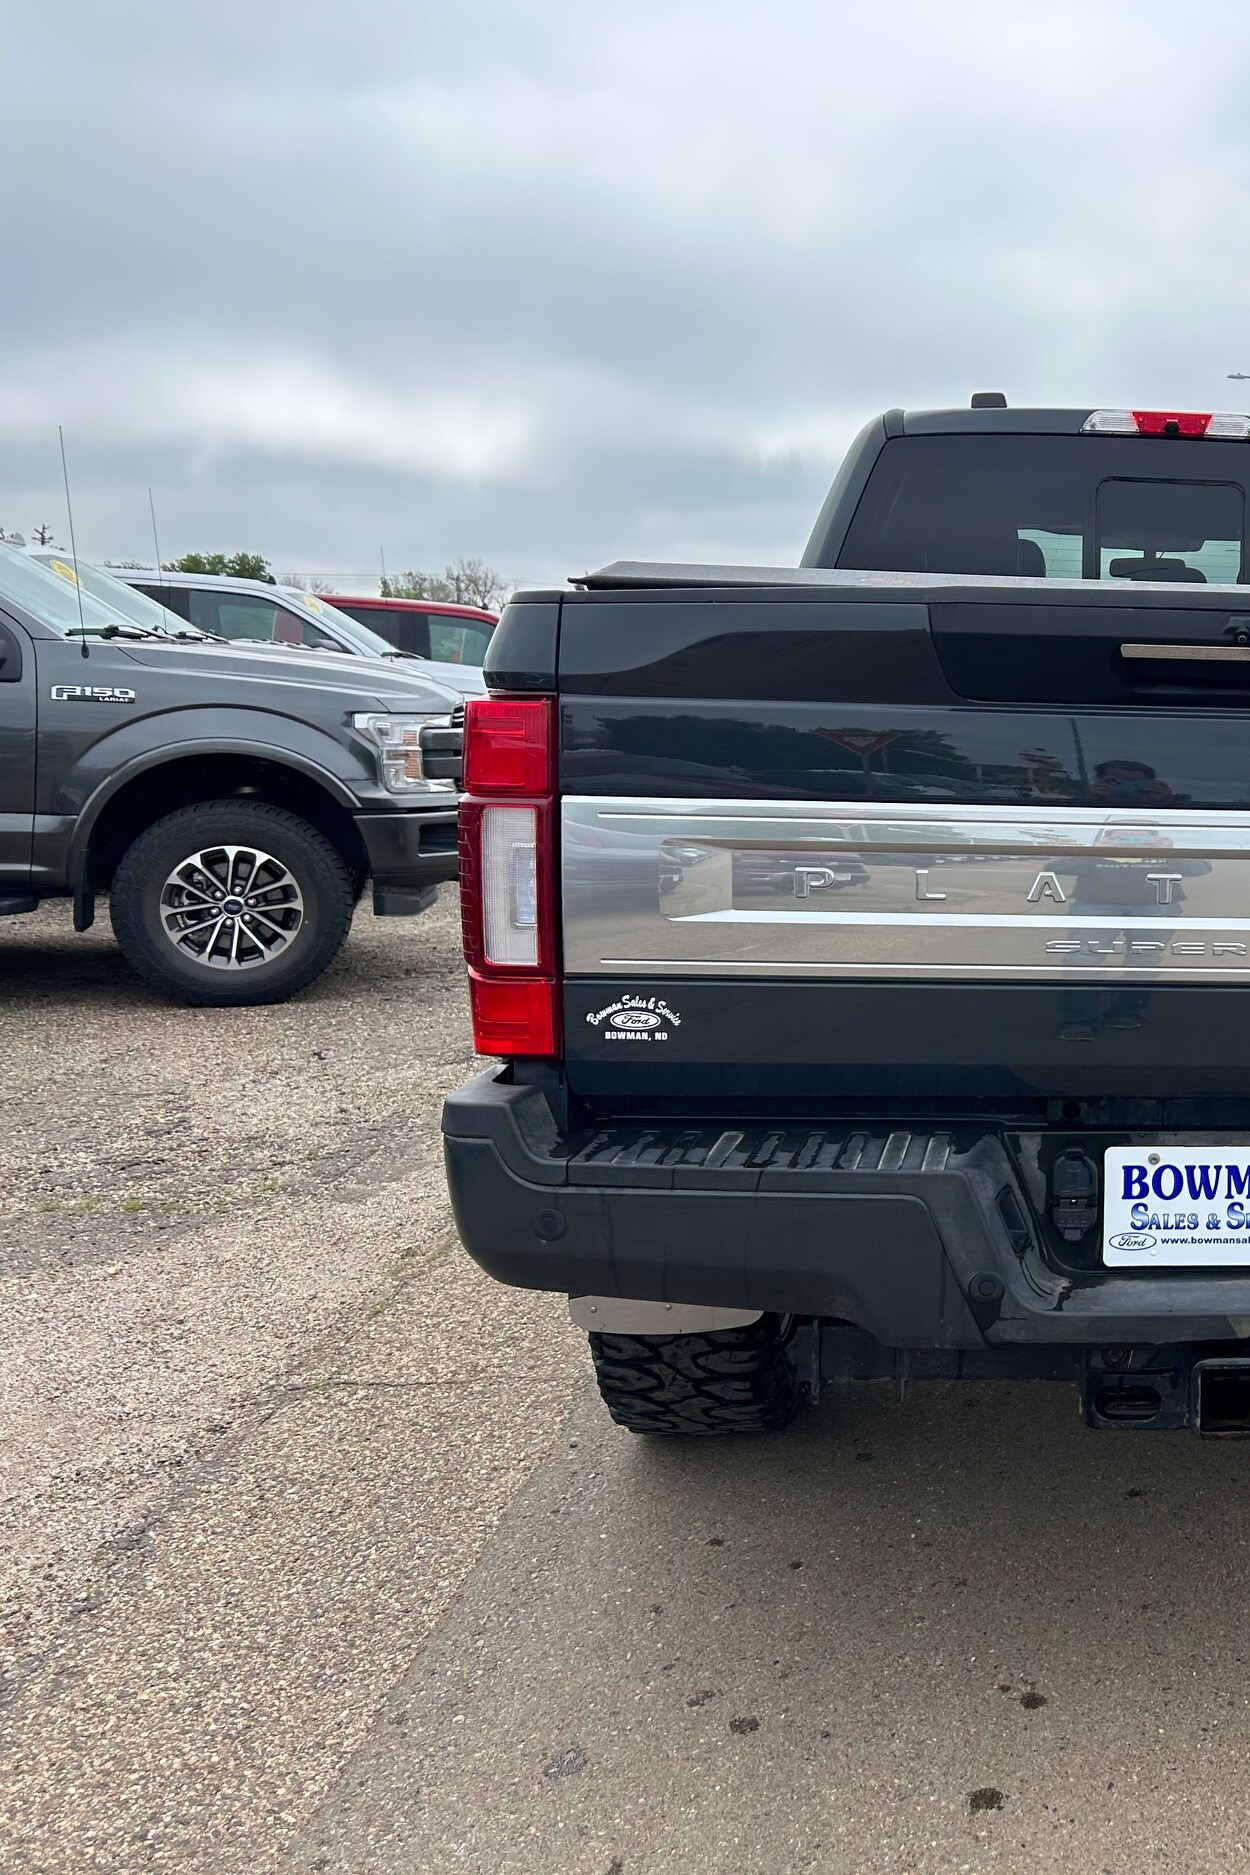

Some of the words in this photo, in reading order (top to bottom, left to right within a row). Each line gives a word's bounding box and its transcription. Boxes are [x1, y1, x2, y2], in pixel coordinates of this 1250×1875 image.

[1045, 939, 1247, 956] SUPER
[585, 1001, 623, 1026] Bowman
[622, 994, 647, 1009] Sales
[647, 997, 656, 1010] &
[655, 1001, 682, 1027] Service
[621, 1015, 651, 1026] Ford
[604, 1031, 652, 1042] BOWMAN,
[654, 1032, 668, 1041] ND
[1206, 1213, 1221, 1230] &
[1118, 1235, 1147, 1248] Ford
